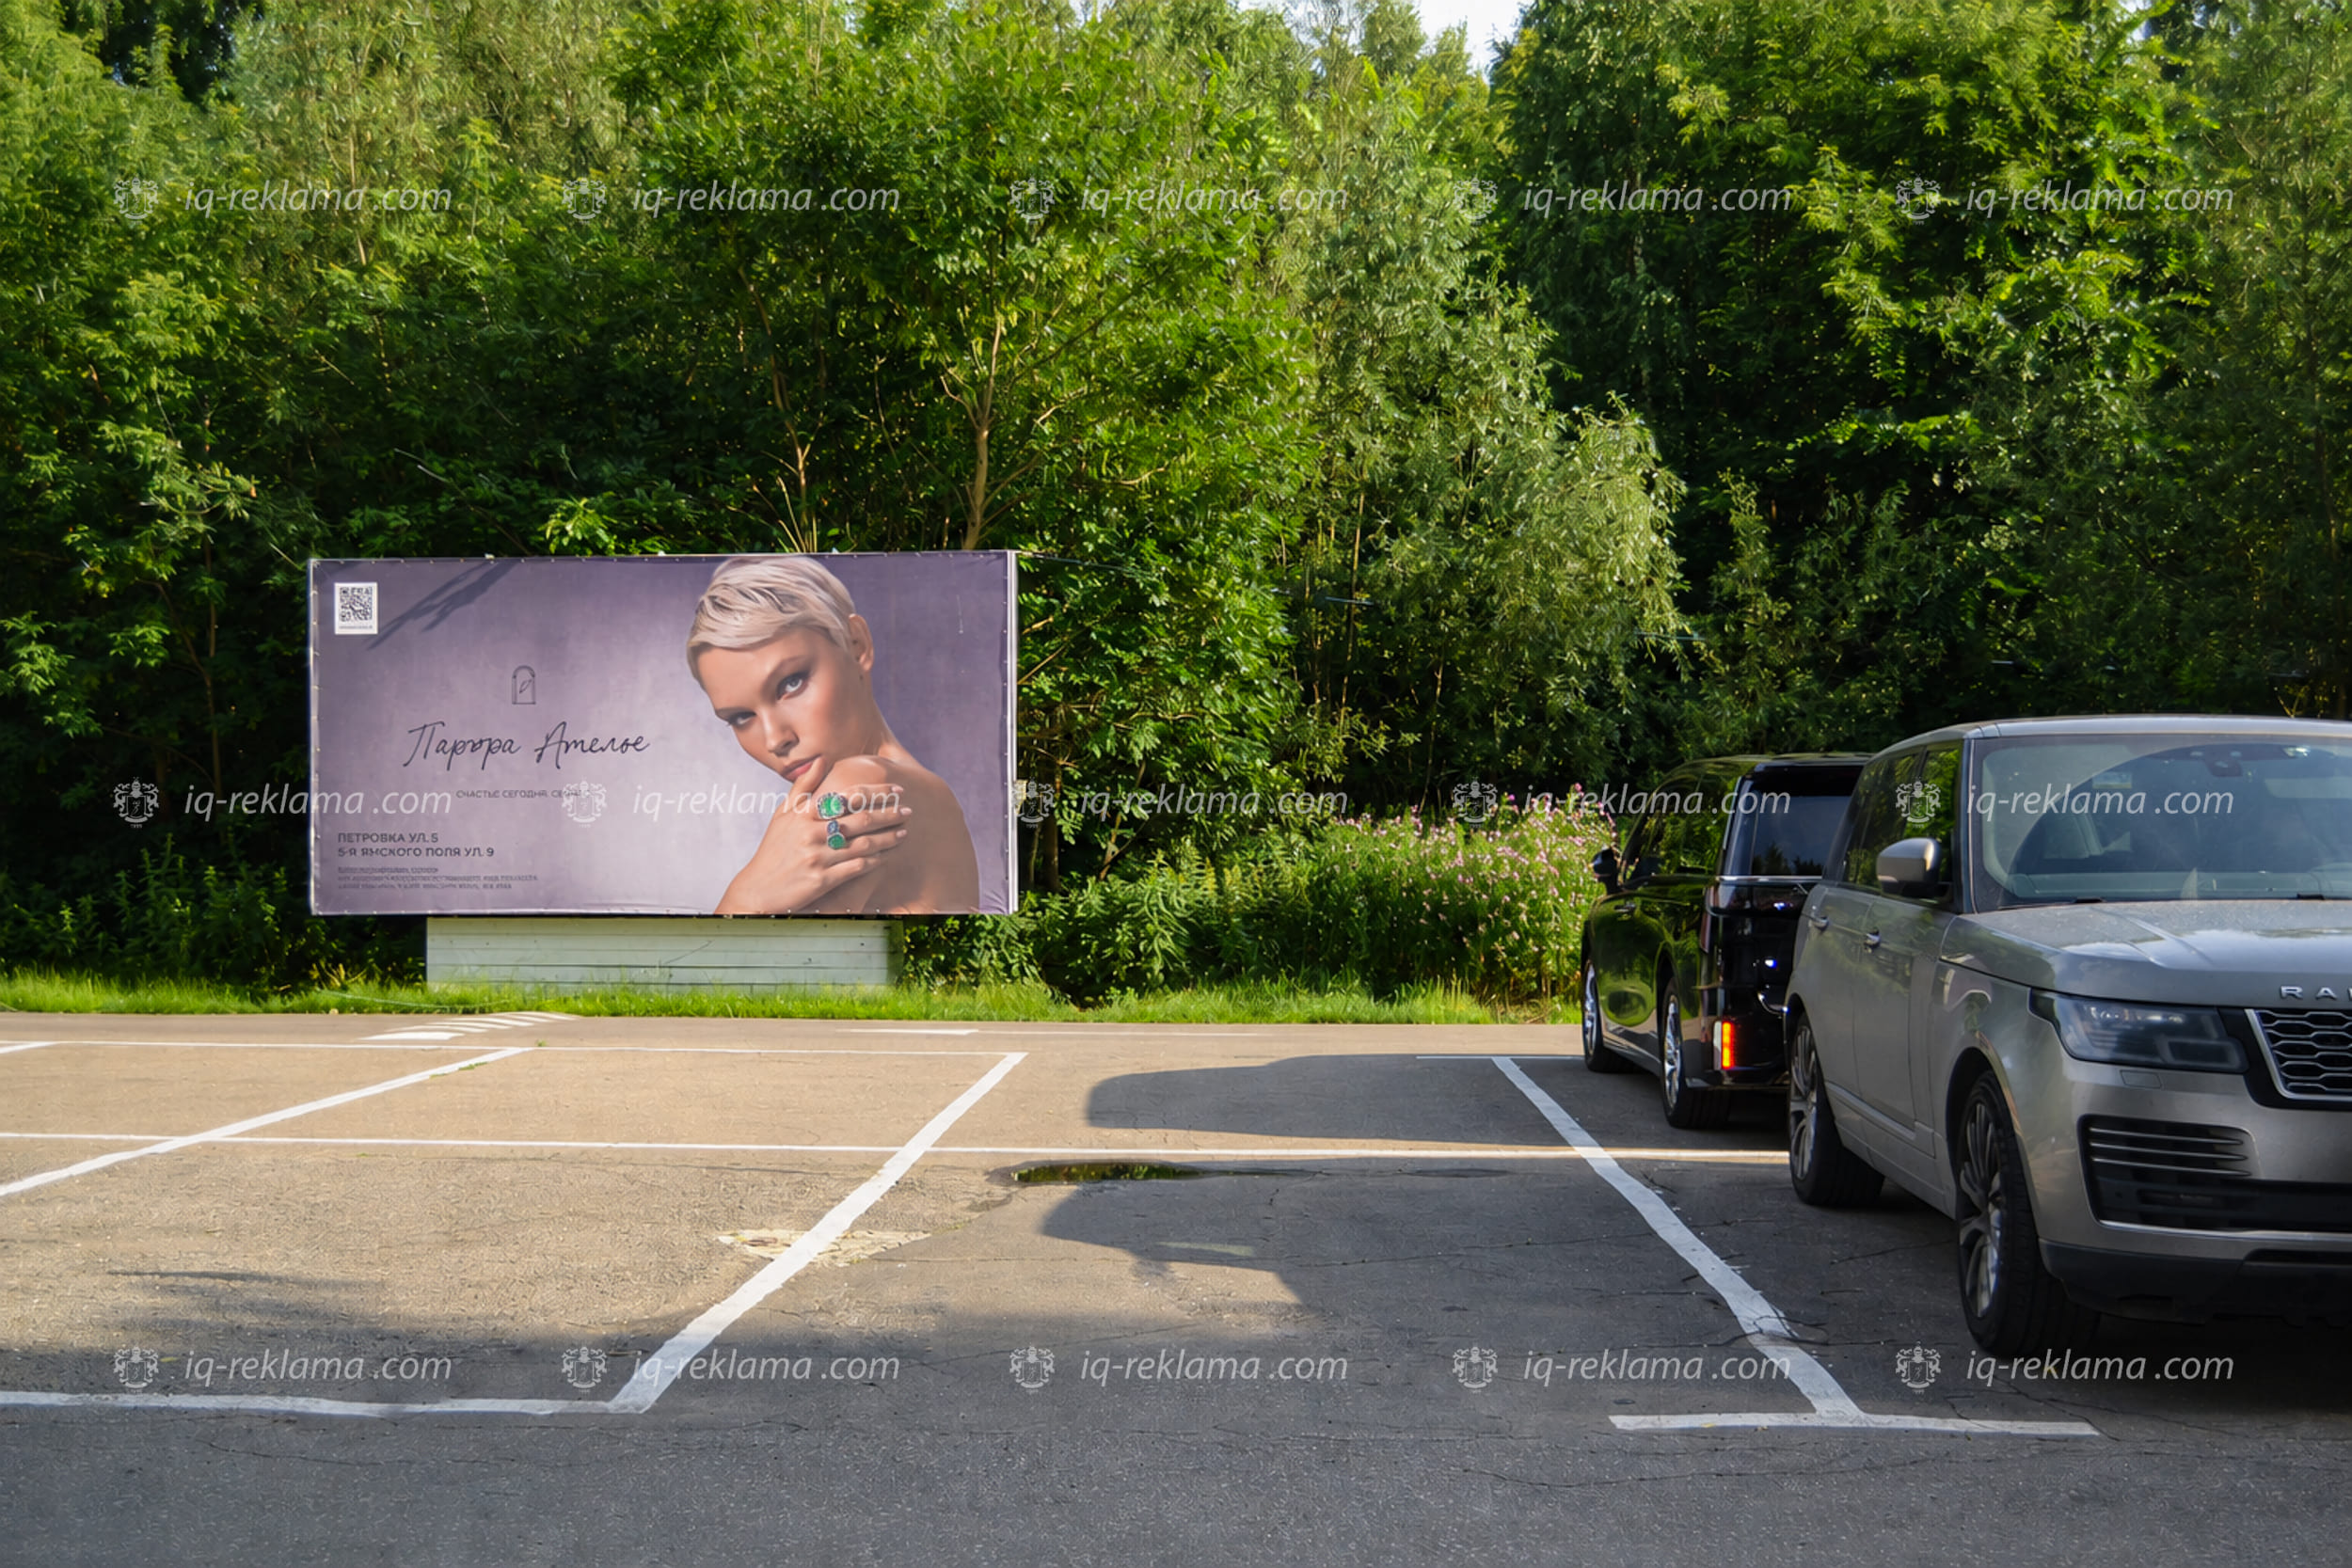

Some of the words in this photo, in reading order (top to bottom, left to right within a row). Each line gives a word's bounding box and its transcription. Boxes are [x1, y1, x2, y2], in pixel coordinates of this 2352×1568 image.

[534, 721, 651, 769] Ателье
[338, 832, 405, 843] ПЕТРОВКА
[408, 832, 429, 843] УЛ.
[431, 832, 438, 843] 5
[338, 847, 357, 857] 5-Я
[360, 847, 422, 857] ЯМСКОГО
[425, 847, 461, 857] ПОЛЯ
[486, 847, 495, 857] 9
[2280, 985, 2352, 1001] RA
